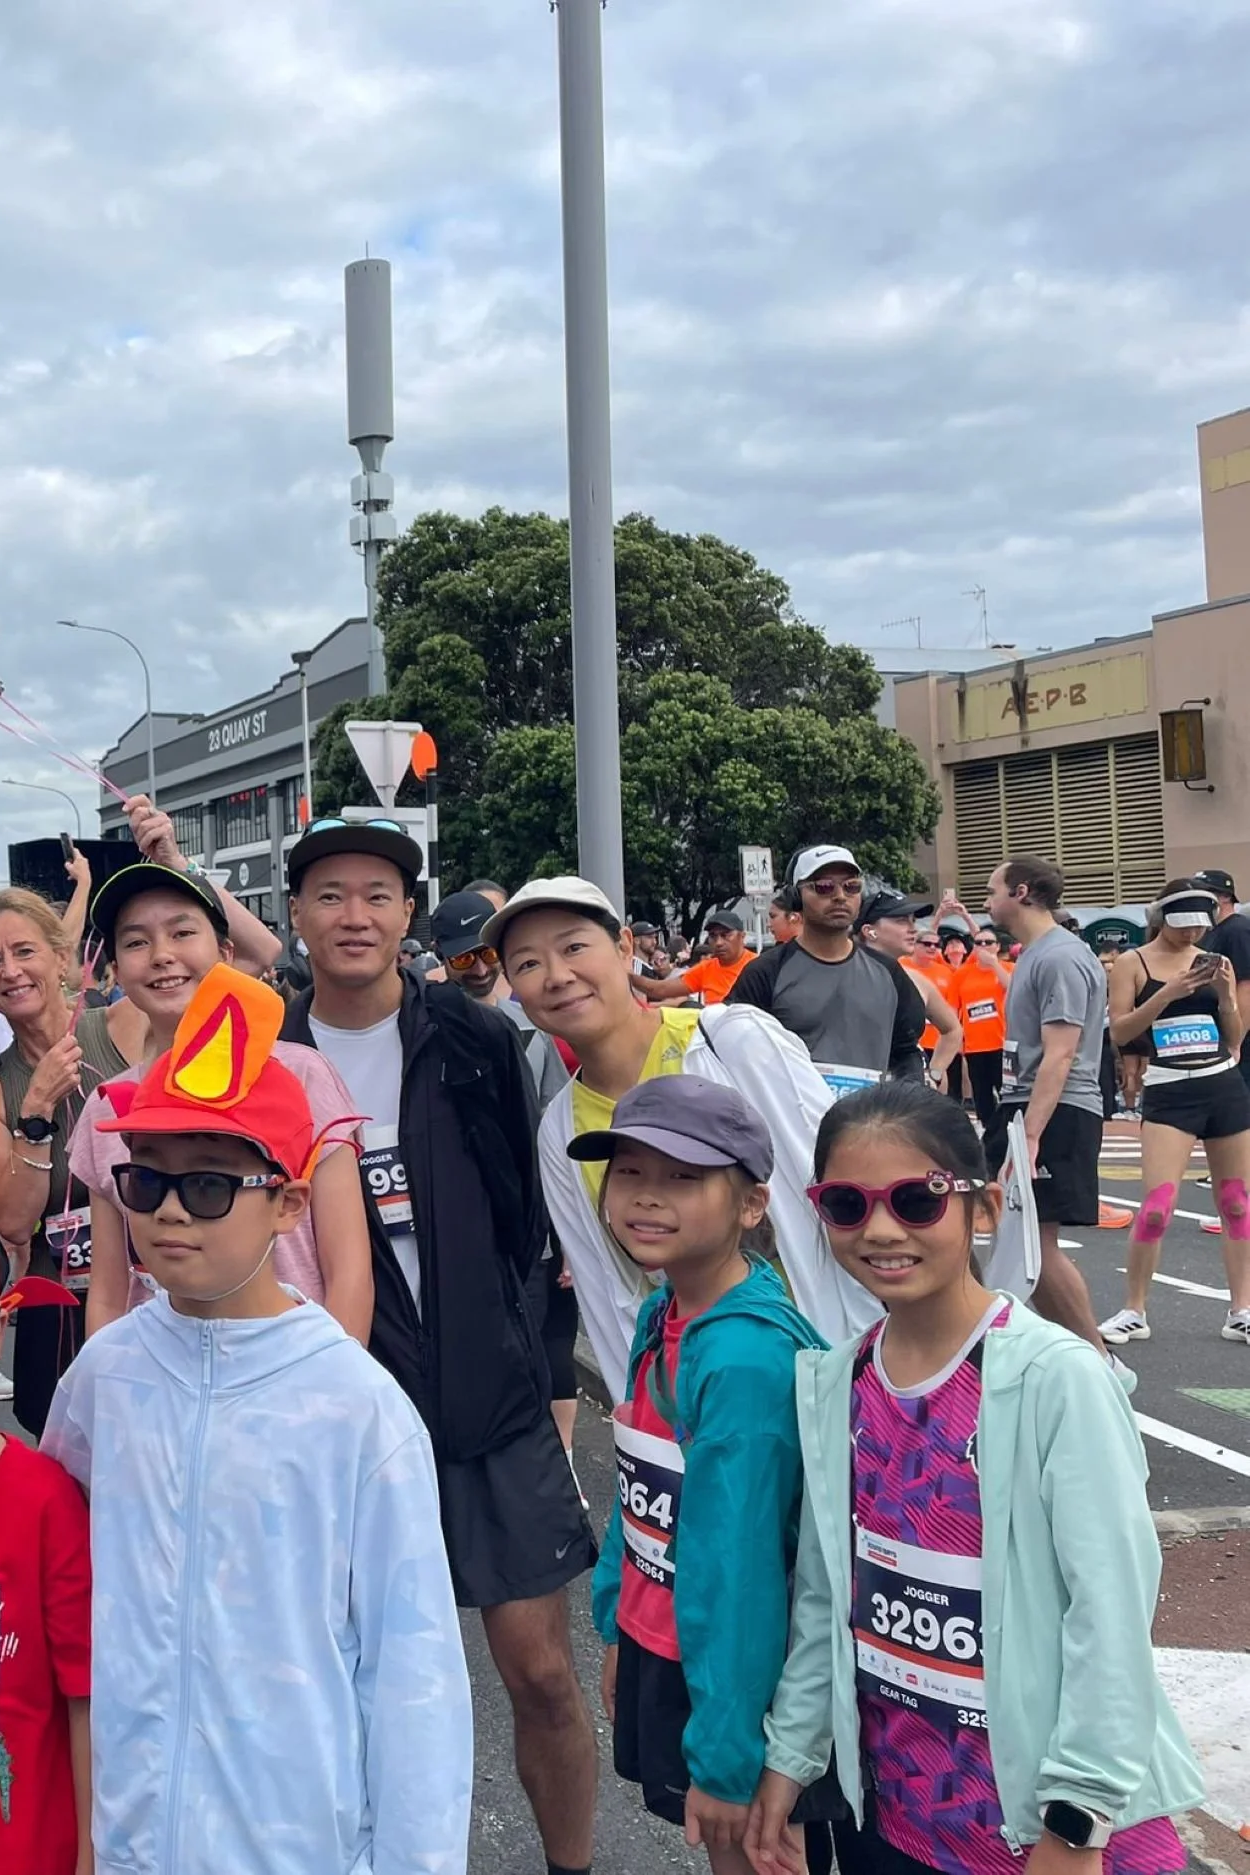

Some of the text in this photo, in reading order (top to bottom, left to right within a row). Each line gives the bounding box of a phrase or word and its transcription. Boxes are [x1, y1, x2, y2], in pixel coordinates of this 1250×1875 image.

[209, 710, 267, 752] 23 QUAY ST
[1162, 1029, 1211, 1045] 14808
[619, 1471, 673, 1528] 964
[903, 1585, 950, 1606] JOGGER
[871, 1592, 984, 1660] 3296
[879, 1684, 918, 1709] GEAR TAG
